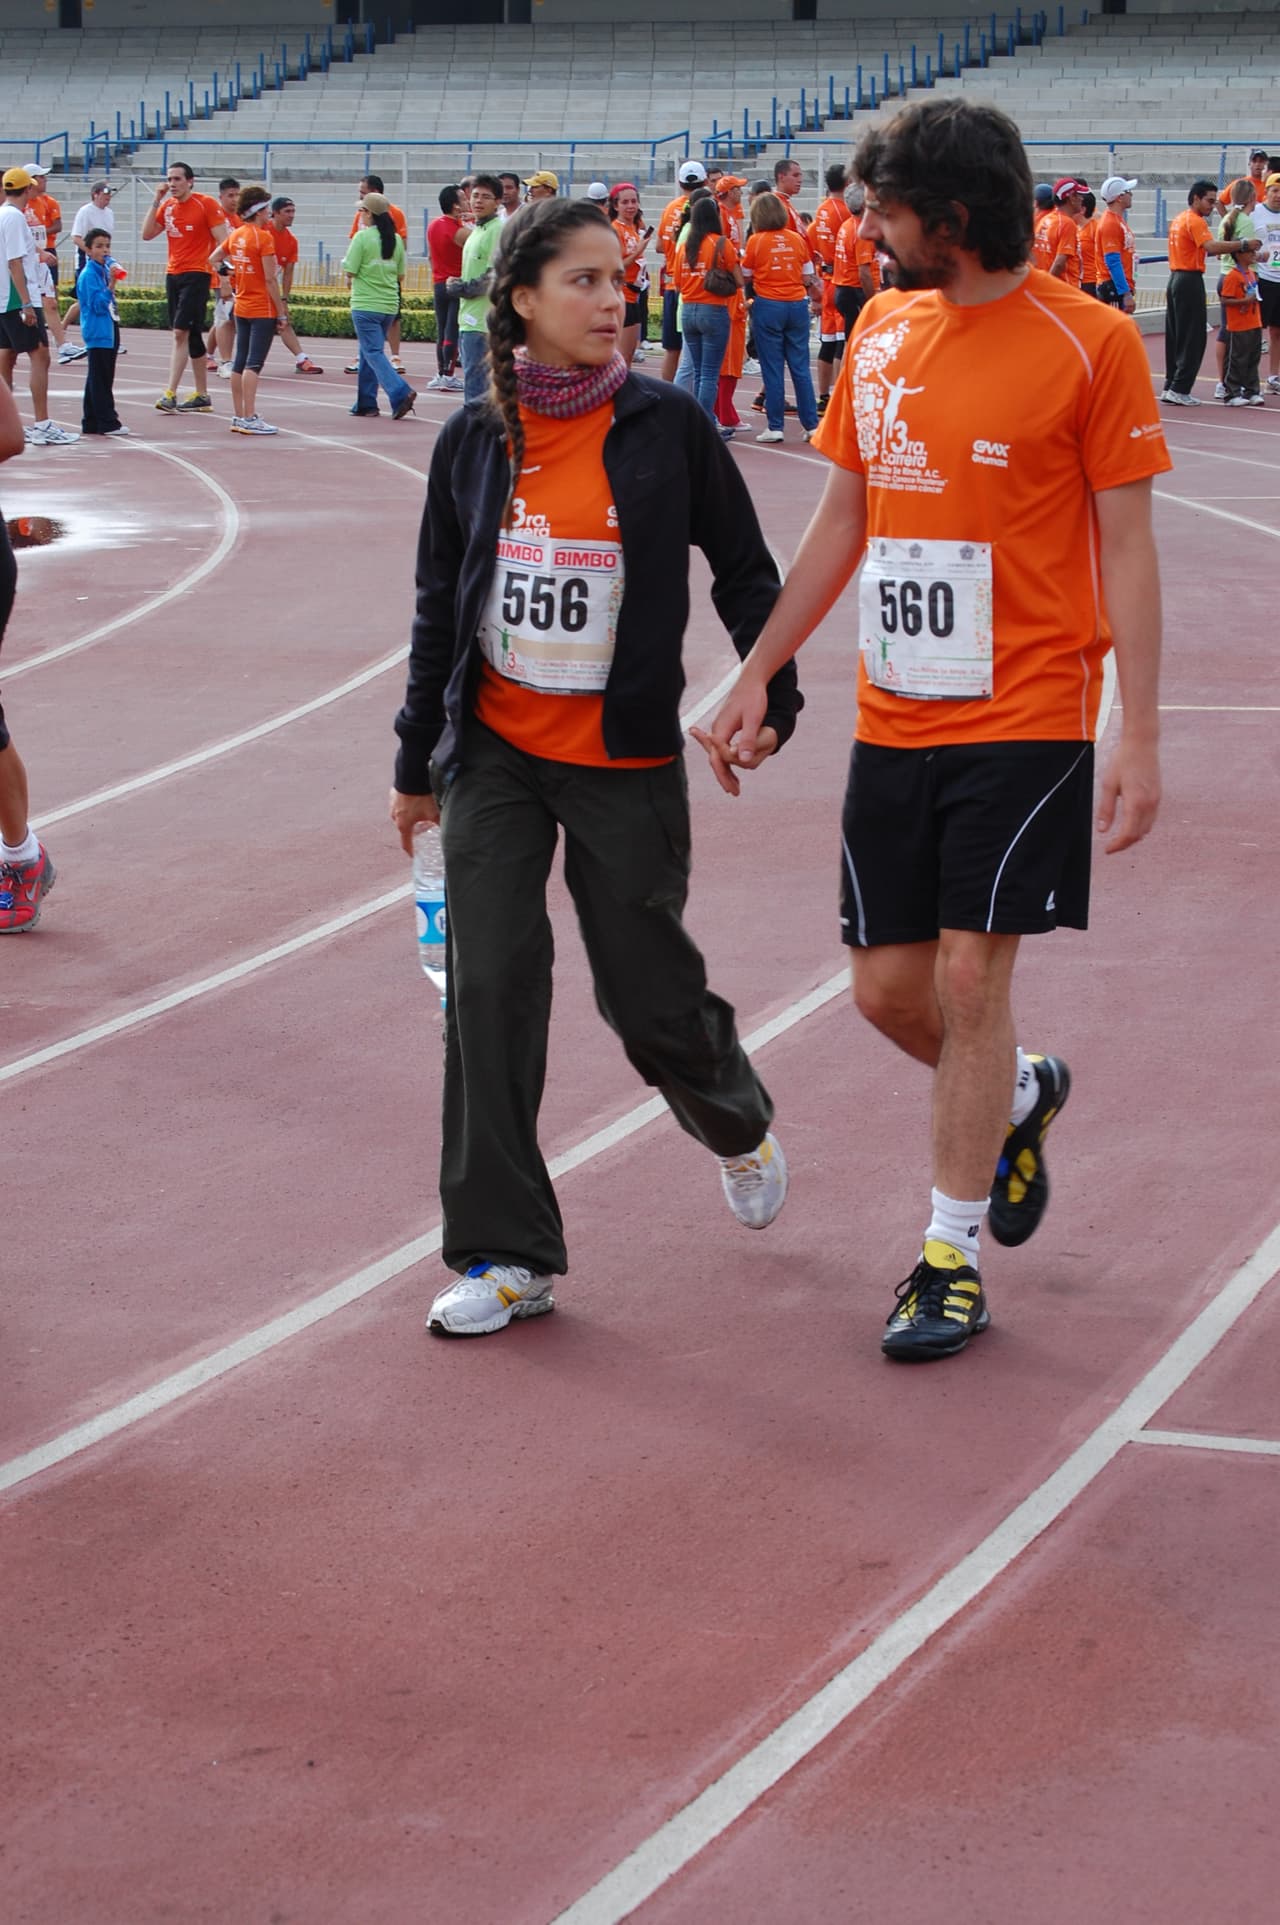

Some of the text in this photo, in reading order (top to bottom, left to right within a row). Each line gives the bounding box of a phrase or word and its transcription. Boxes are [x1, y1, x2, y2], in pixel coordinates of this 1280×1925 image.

[890, 420, 928, 456] 3ra.
[880, 449, 928, 468] Carrera
[512, 498, 551, 528] 3ra.
[554, 550, 617, 568] BIMBO
[502, 570, 589, 633] 556
[879, 579, 954, 638] 560
